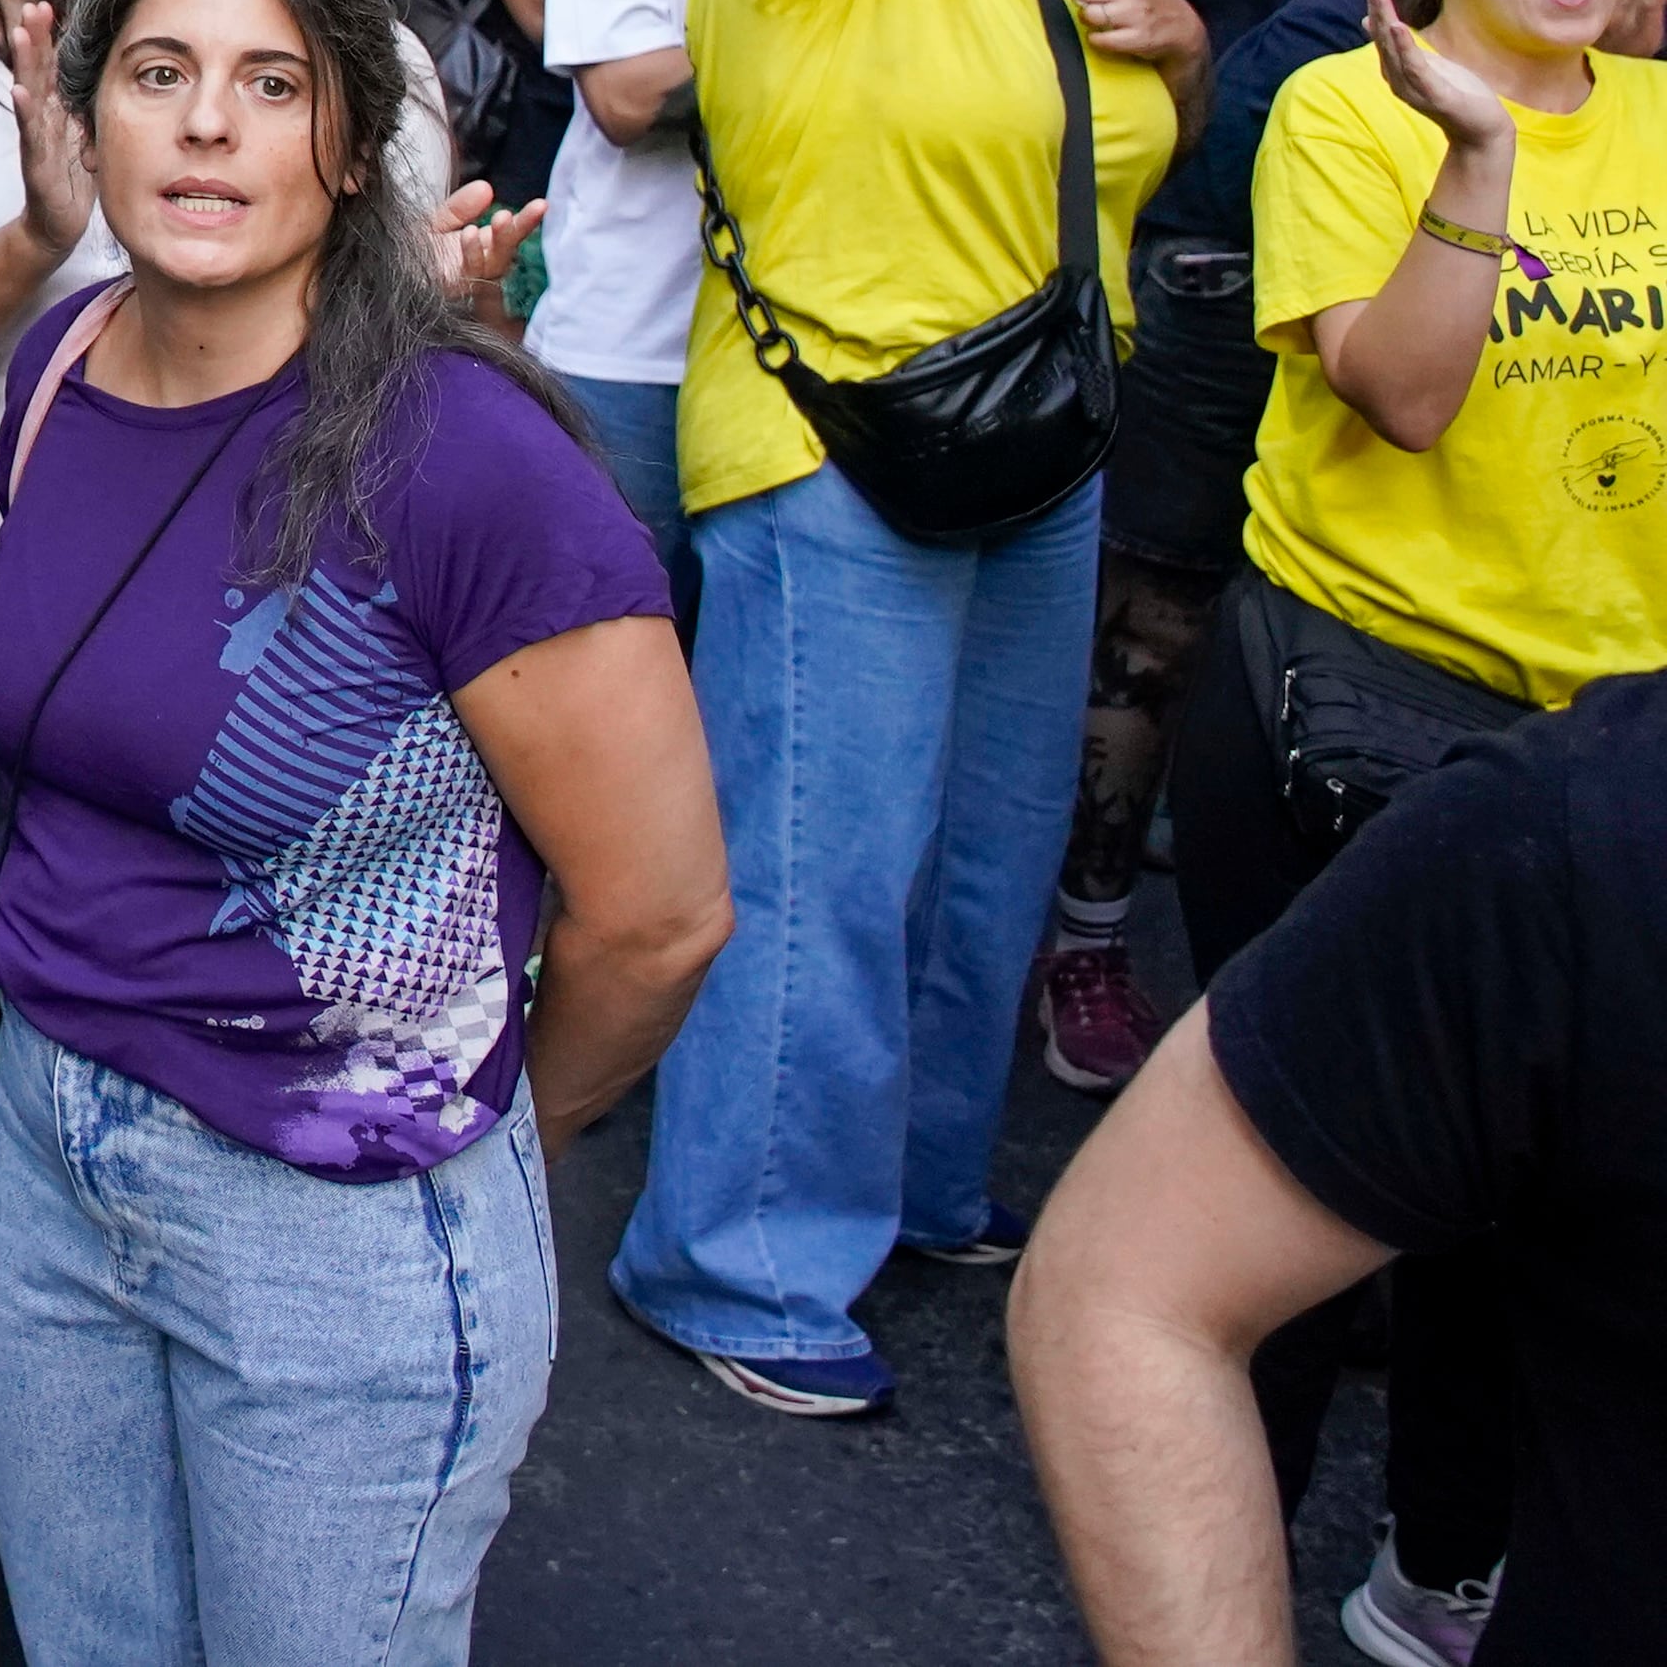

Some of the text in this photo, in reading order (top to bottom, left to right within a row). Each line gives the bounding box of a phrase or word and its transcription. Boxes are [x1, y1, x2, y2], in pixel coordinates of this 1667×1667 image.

[1524, 206, 1657, 238] LA VIDA
[1500, 246, 1638, 278] DBERÍA
[1488, 280, 1667, 344] MARI
[1494, 354, 1604, 389] (AMAR
[1639, 351, 1657, 377] Y
